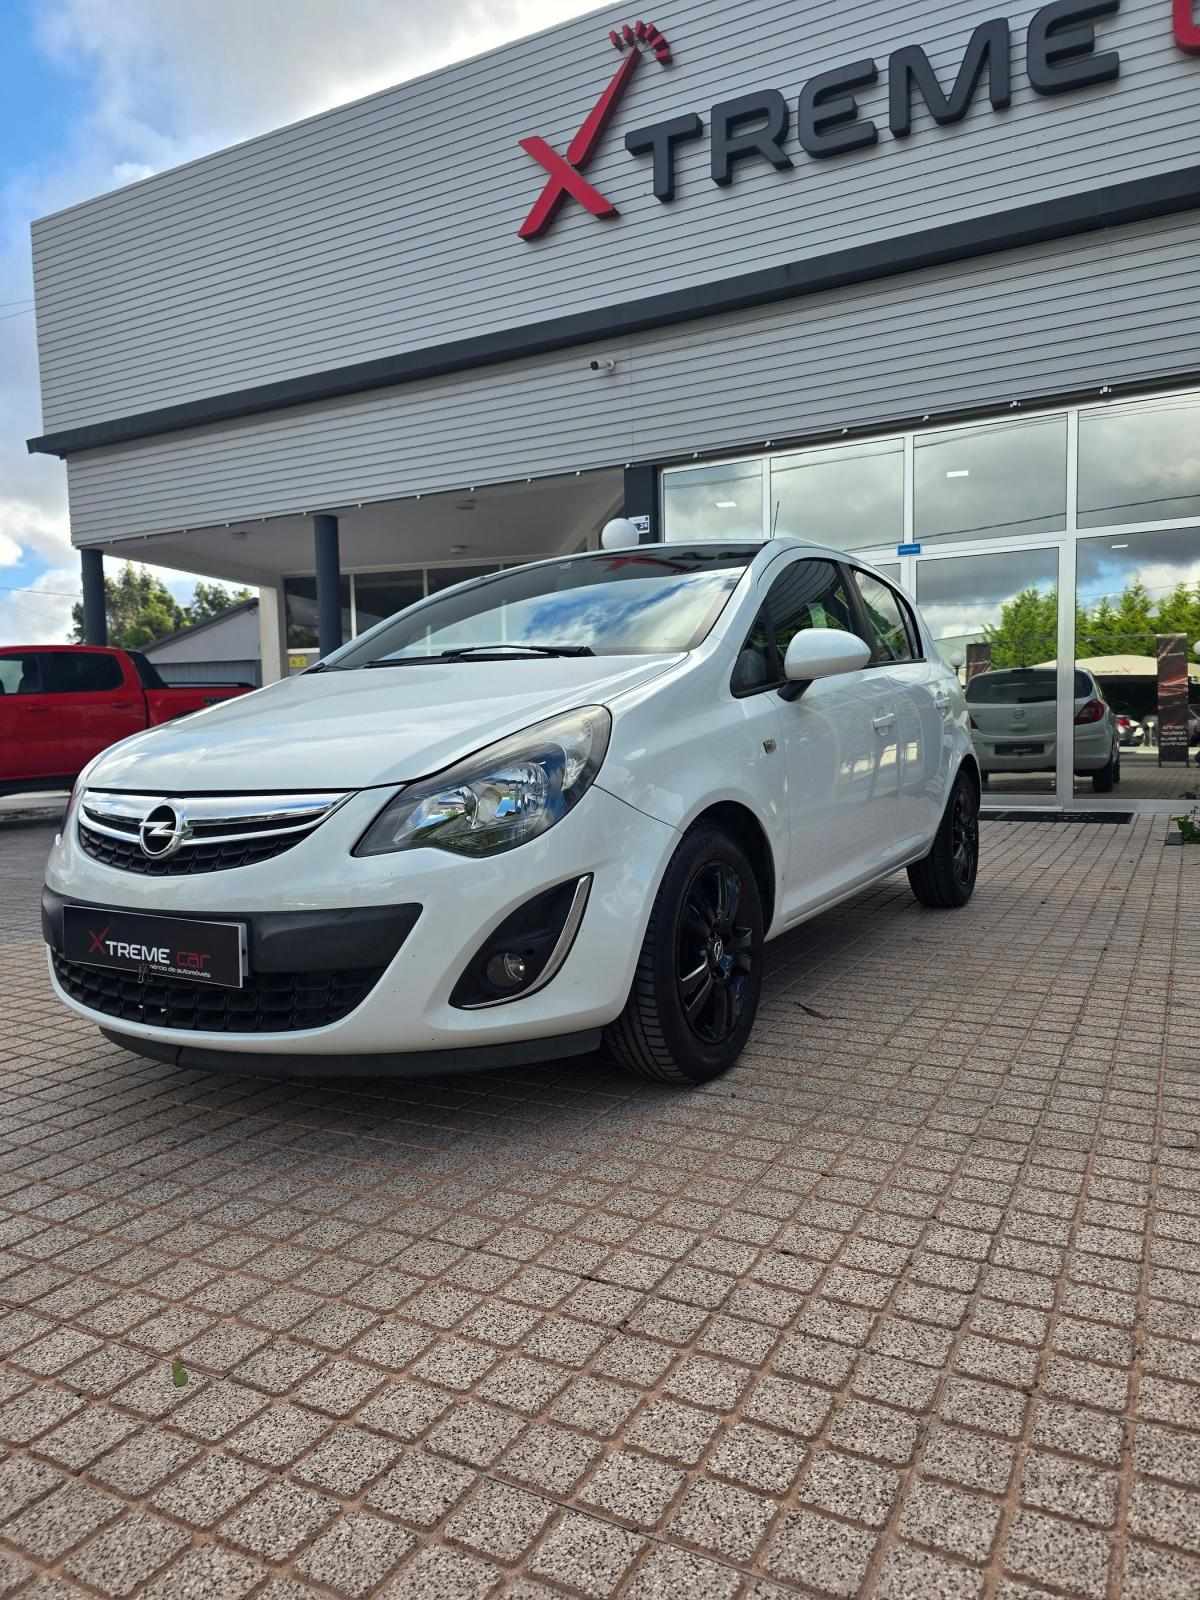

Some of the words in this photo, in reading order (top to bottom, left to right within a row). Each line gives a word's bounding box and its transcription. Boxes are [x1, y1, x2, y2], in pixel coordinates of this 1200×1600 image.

[517, 0, 1120, 241] XTREME
[88, 927, 171, 965] XTREME
[175, 951, 211, 970] car
